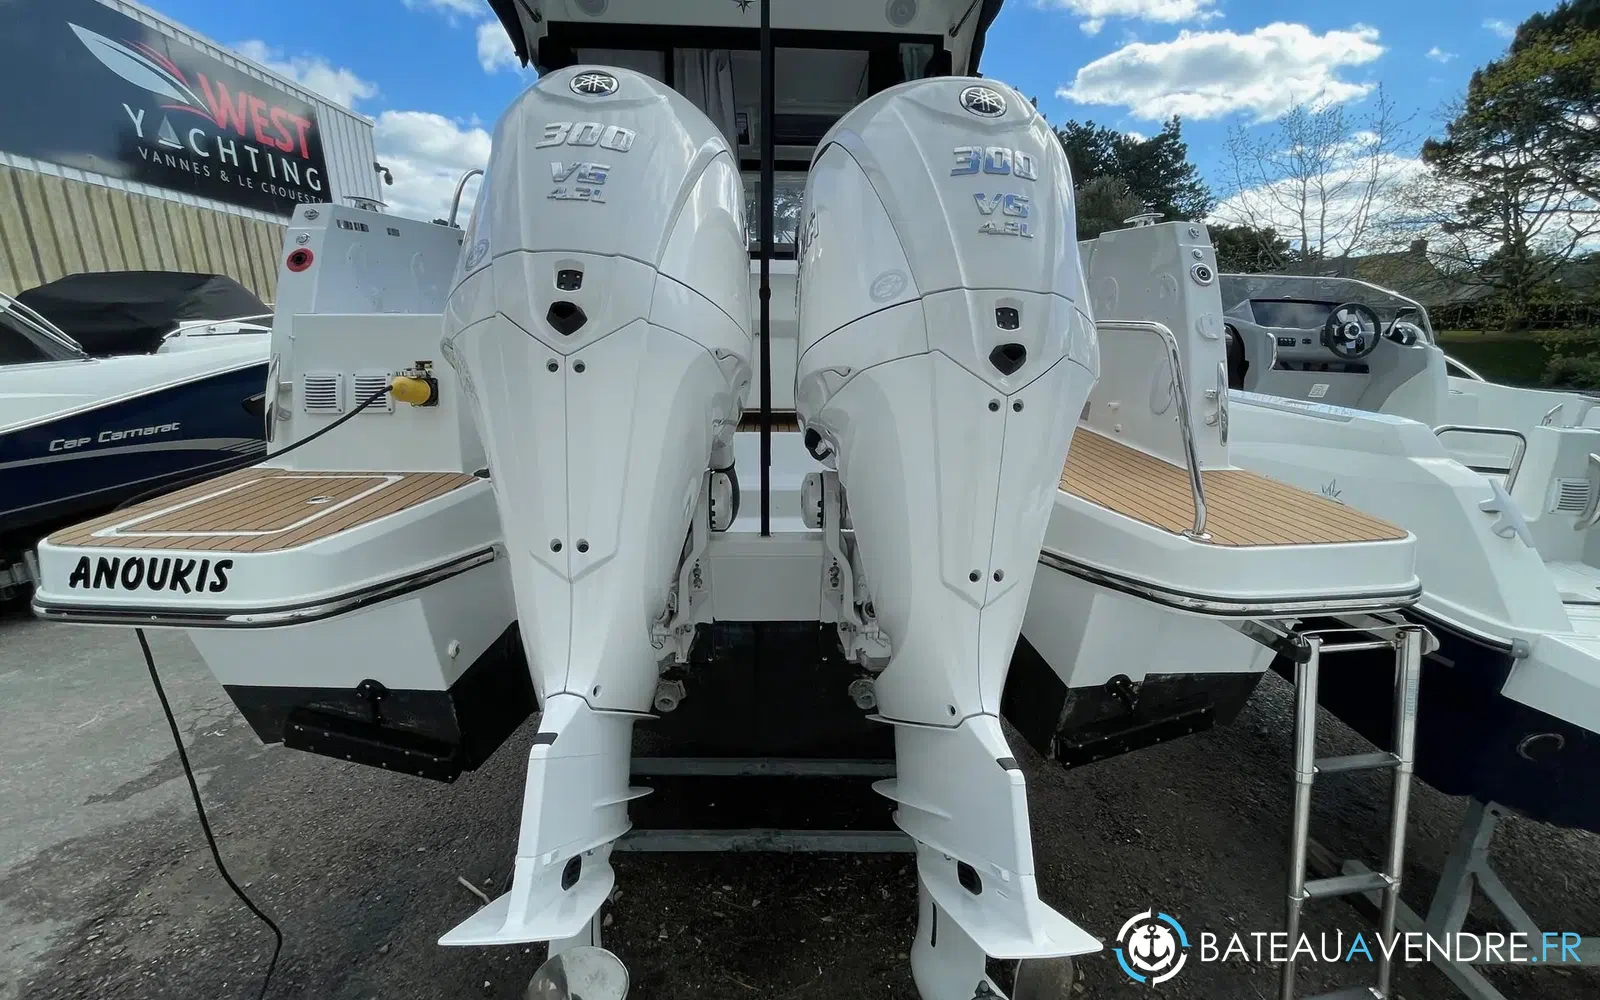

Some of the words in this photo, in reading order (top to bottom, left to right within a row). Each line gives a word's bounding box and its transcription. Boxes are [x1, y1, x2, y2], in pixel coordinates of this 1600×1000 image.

[196, 72, 311, 159] WEST
[122, 102, 322, 191] YACHTING
[535, 121, 637, 153] 300
[138, 146, 211, 177] VANNES
[220, 170, 230, 183] &
[238, 174, 253, 189] LE
[261, 182, 324, 204] CROUESTY
[550, 161, 611, 185] V6
[951, 146, 1038, 181] 300
[974, 193, 1030, 218] V6
[98, 422, 181, 443] Camarat
[69, 556, 234, 594] ANOUKIS
